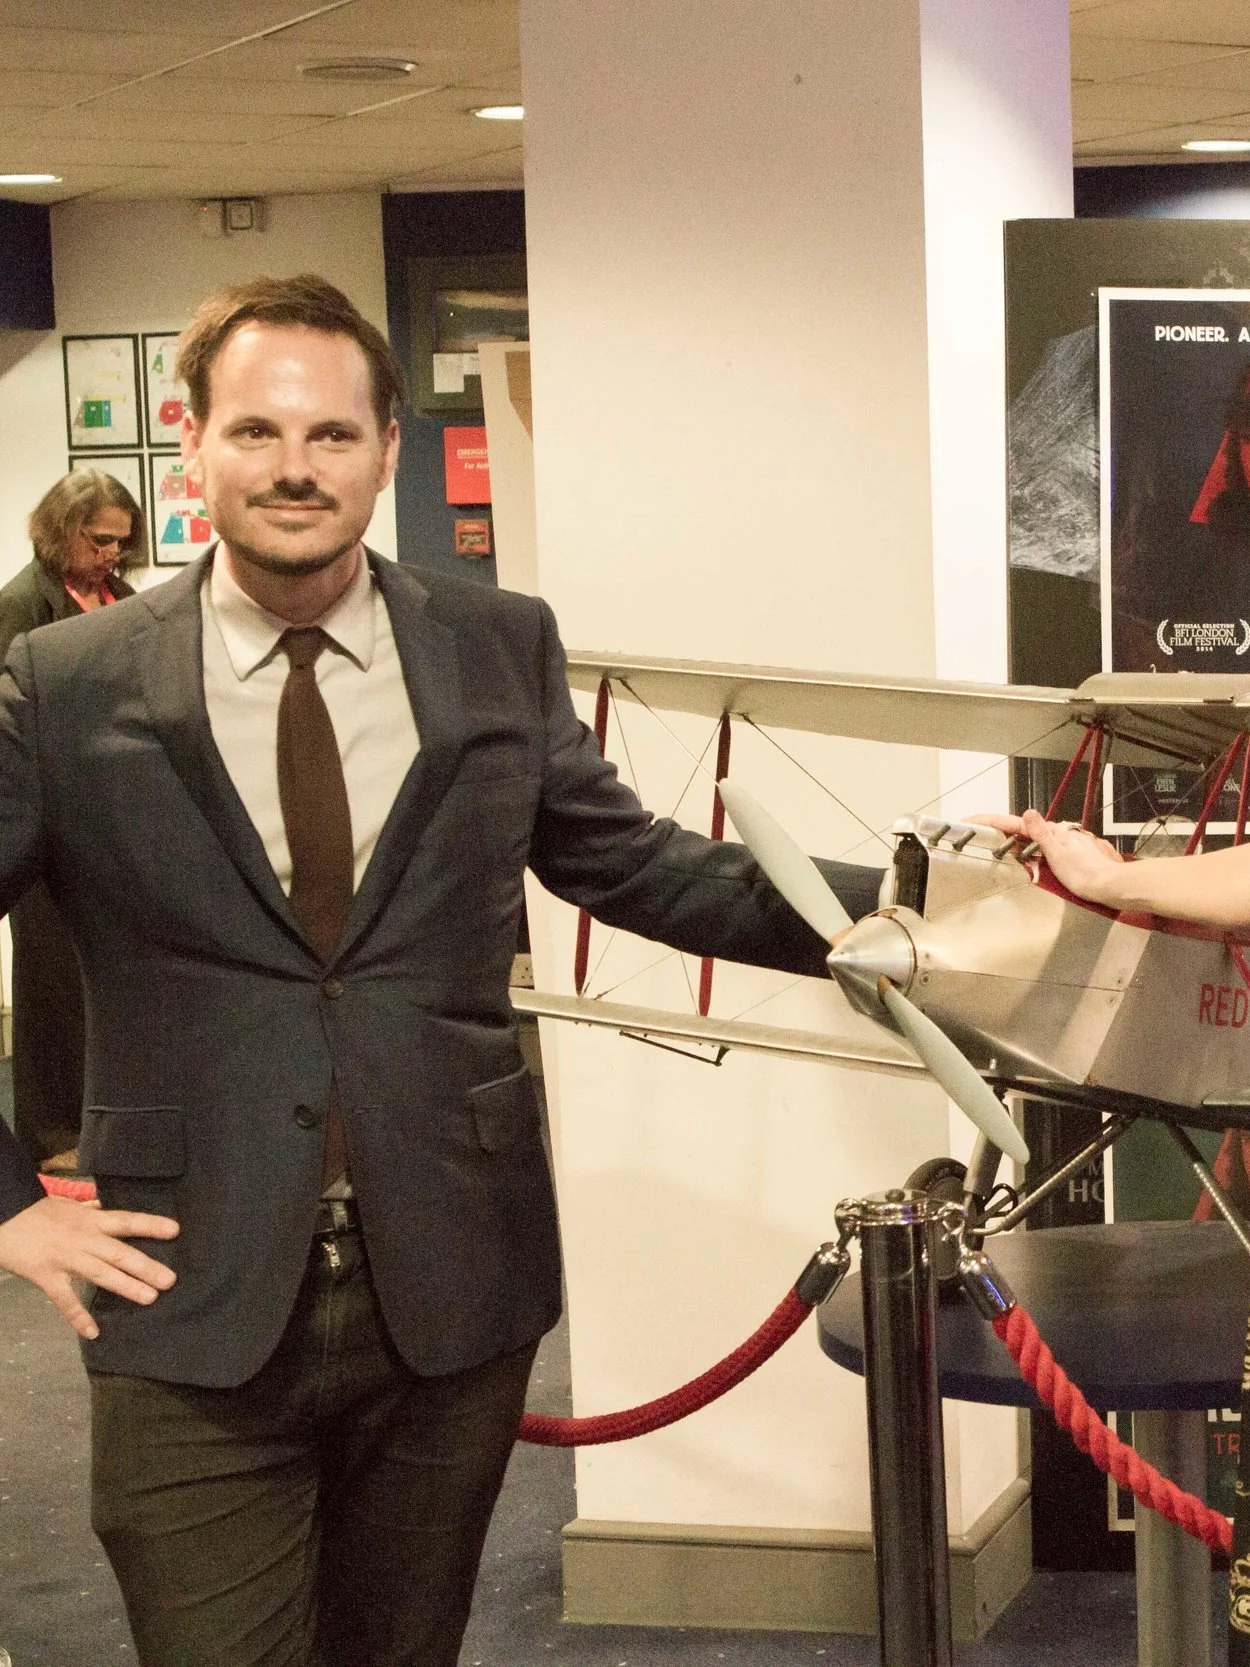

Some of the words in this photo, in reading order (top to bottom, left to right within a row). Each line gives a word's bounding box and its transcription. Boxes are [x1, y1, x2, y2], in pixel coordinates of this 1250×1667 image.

[1155, 325, 1229, 342] PIONEER.
[1175, 629, 1189, 638] BFI
[1191, 629, 1234, 638] LONDON
[1170, 638, 1192, 646] FILM
[1195, 638, 1239, 646] FESTIVAL
[1200, 983, 1248, 1029] RED
